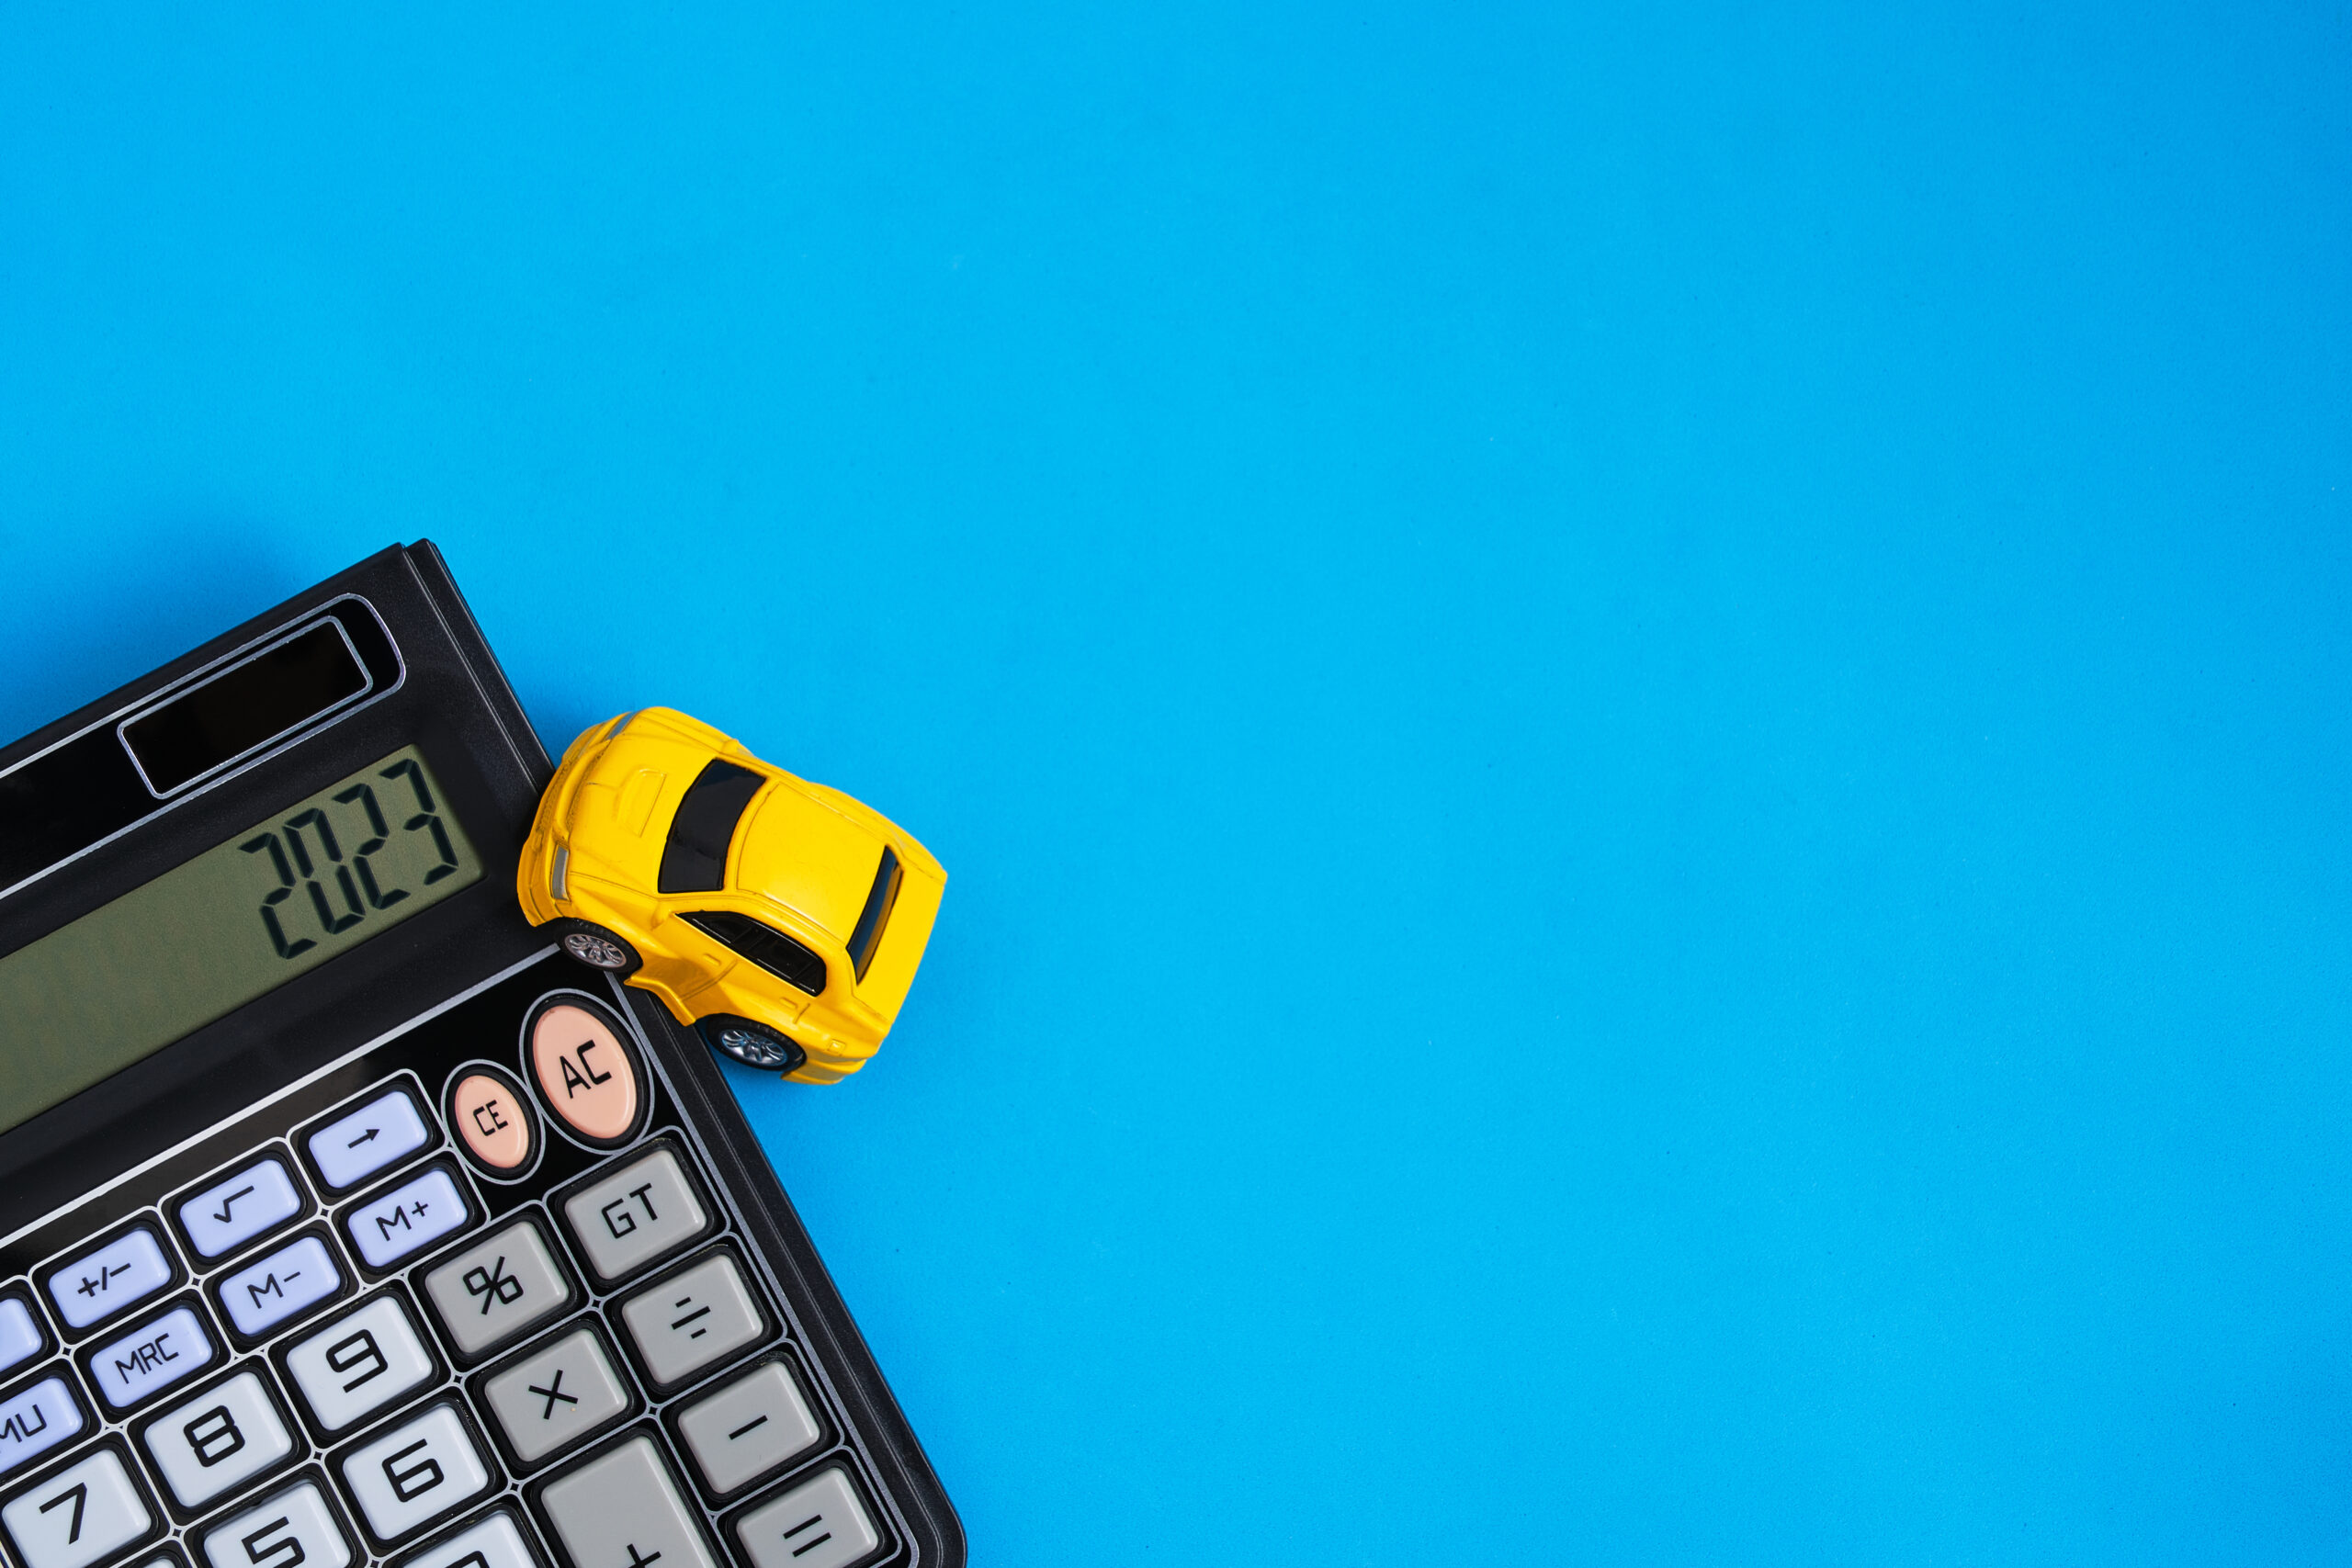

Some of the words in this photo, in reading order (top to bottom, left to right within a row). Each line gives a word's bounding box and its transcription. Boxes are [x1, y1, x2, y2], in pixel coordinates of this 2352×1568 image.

[237, 758, 459, 960] 2023
[560, 1040, 613, 1099] AC
[473, 1100, 509, 1137] CE
[376, 1201, 429, 1241] M+
[602, 1183, 658, 1238] GT
[78, 1263, 131, 1297] +/-
[247, 1272, 301, 1309] M-
[463, 1257, 525, 1314] %
[115, 1333, 179, 1384] MRC
[326, 1329, 389, 1393] 9
[184, 1405, 246, 1468] 8
[382, 1438, 445, 1503] 6
[40, 1483, 88, 1545] 7
[784, 1515, 832, 1558] =
[242, 1517, 306, 1568] 5
